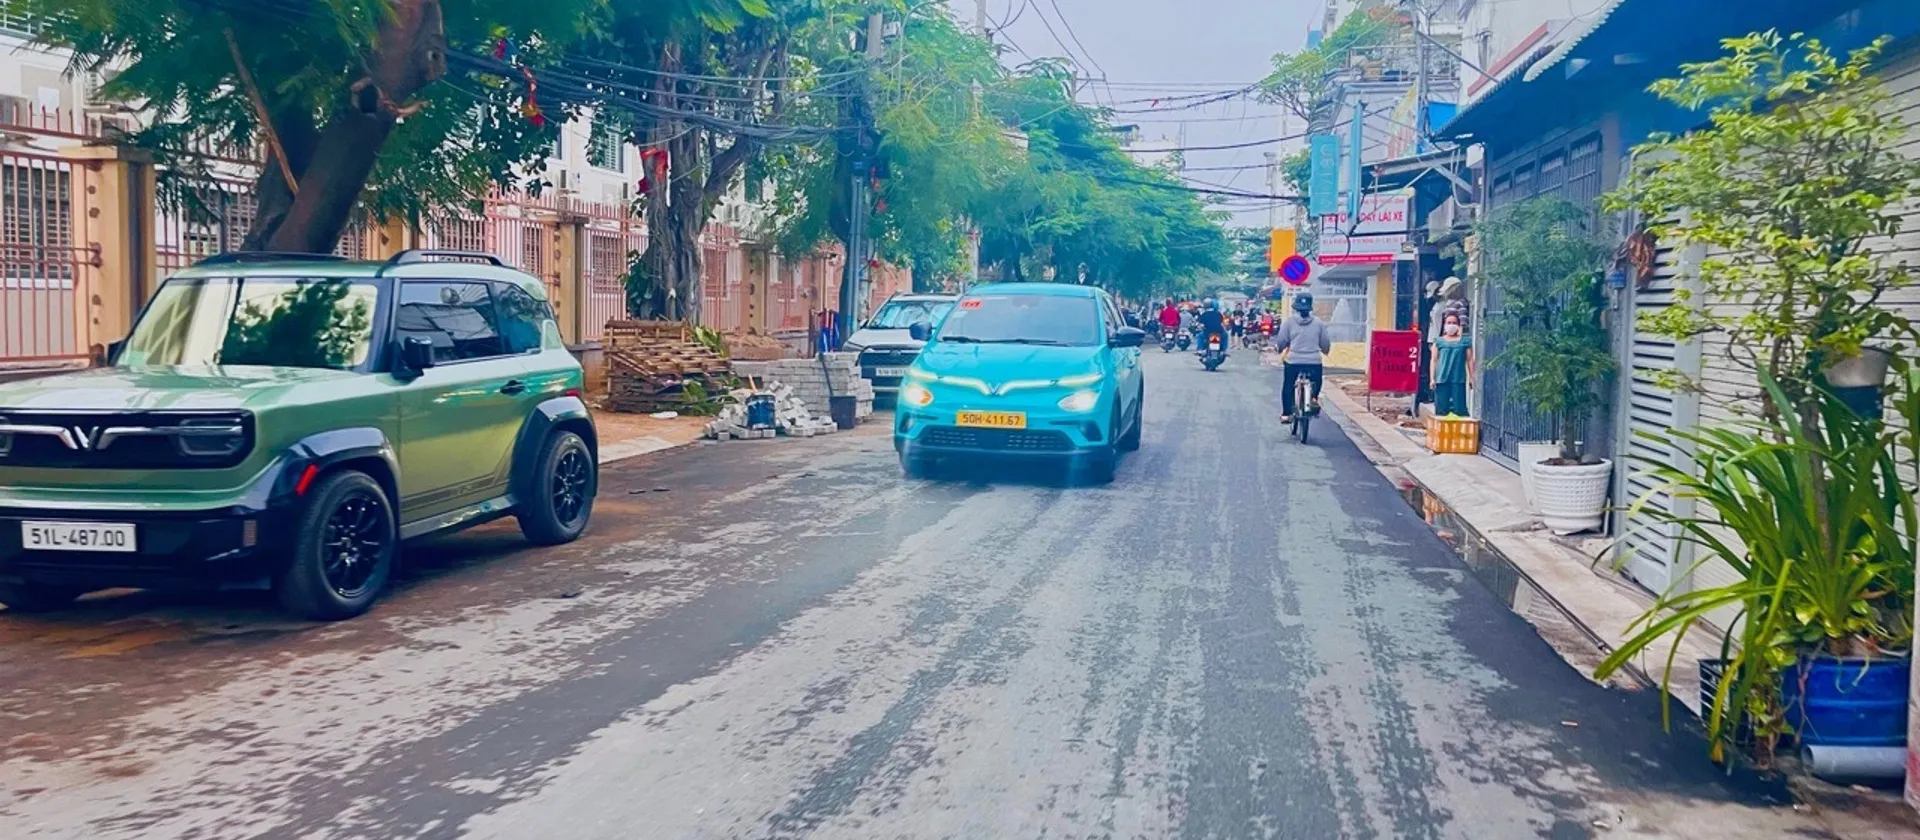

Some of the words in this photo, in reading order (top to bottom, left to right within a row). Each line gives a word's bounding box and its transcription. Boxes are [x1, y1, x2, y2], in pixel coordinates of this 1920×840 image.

[1393, 211, 1403, 222] XE
[1375, 347, 1405, 358] Mua
[1408, 346, 1418, 358] 2
[1410, 361, 1416, 373] 1
[962, 413, 1021, 426] 50H-411.67
[31, 528, 126, 547] 51L-487.00
